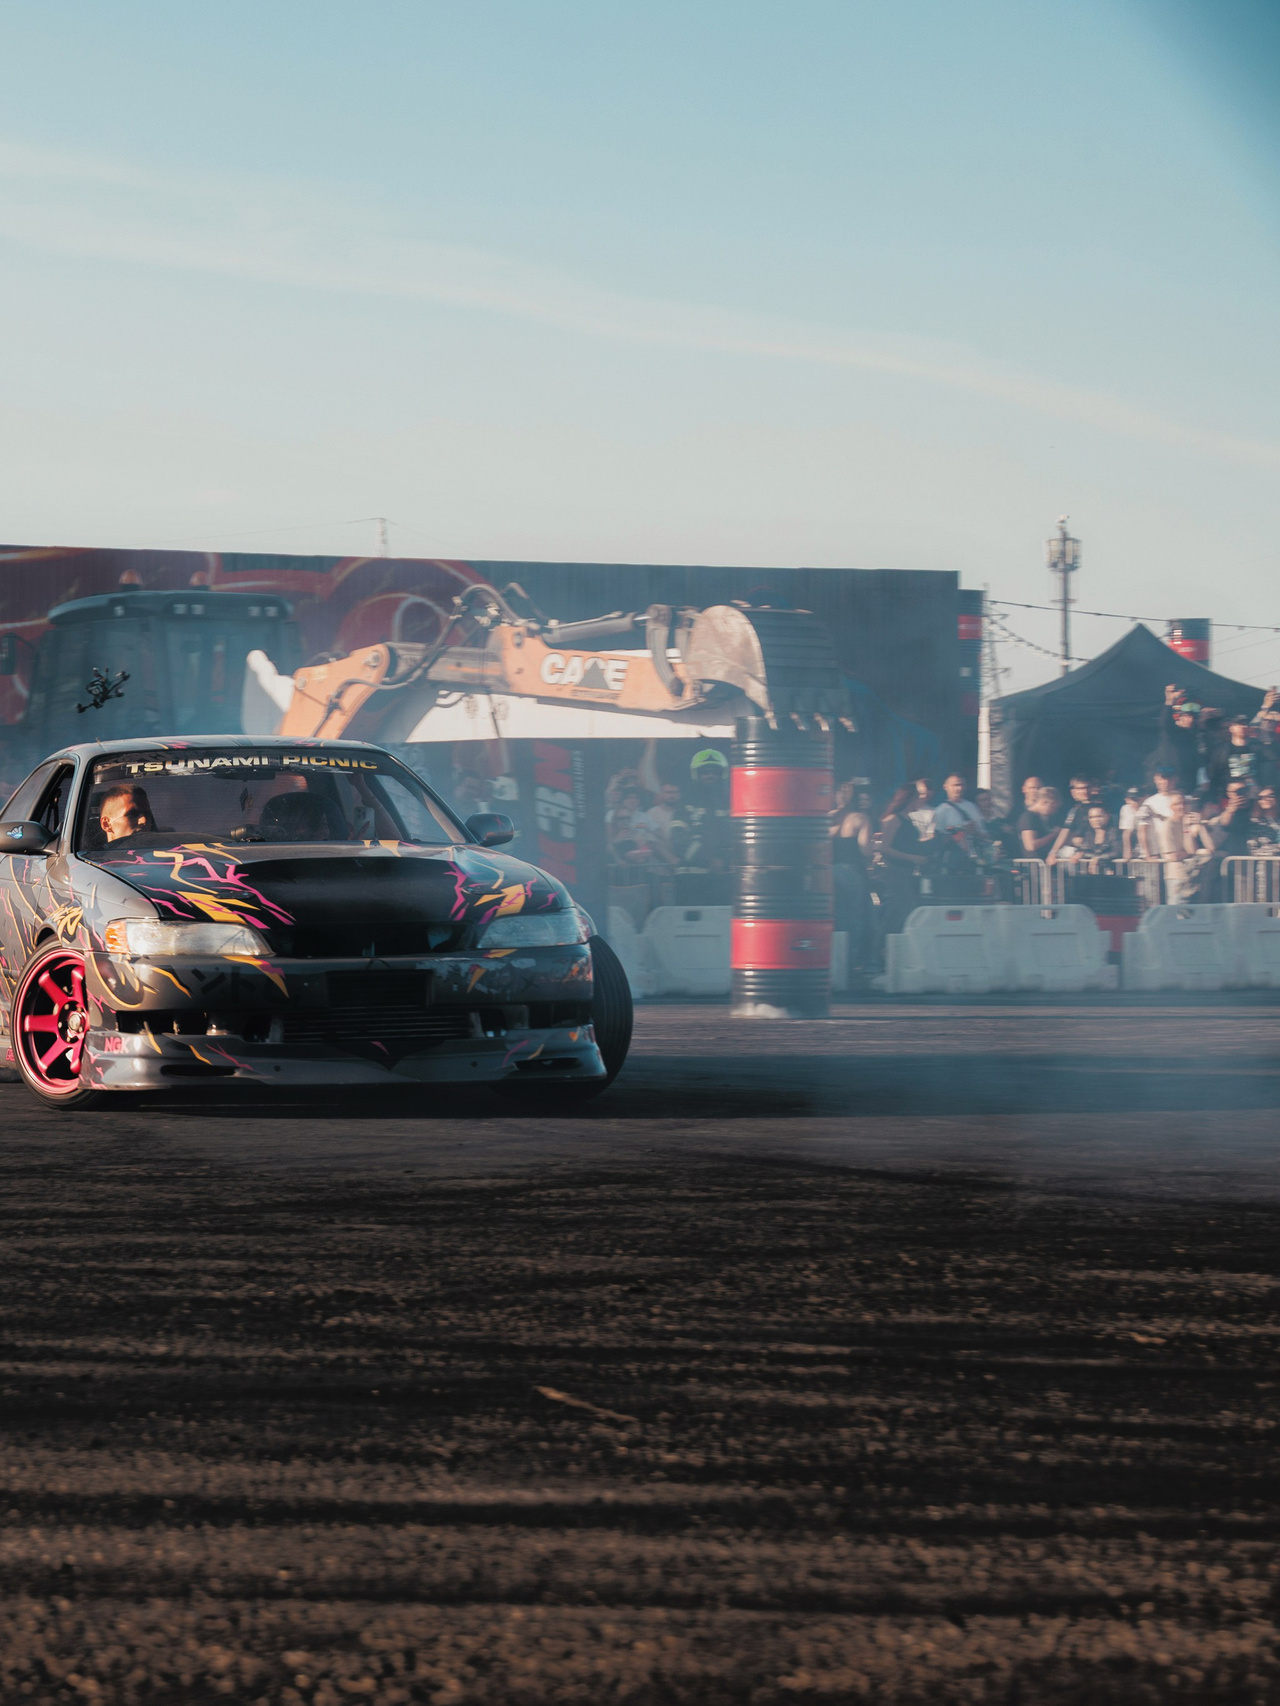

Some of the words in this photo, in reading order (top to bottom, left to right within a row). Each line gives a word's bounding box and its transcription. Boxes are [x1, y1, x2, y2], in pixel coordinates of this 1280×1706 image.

[127, 755, 268, 774] TSUNAMI
[282, 755, 378, 770] PICNIC
[104, 1037, 131, 1054] NGK
